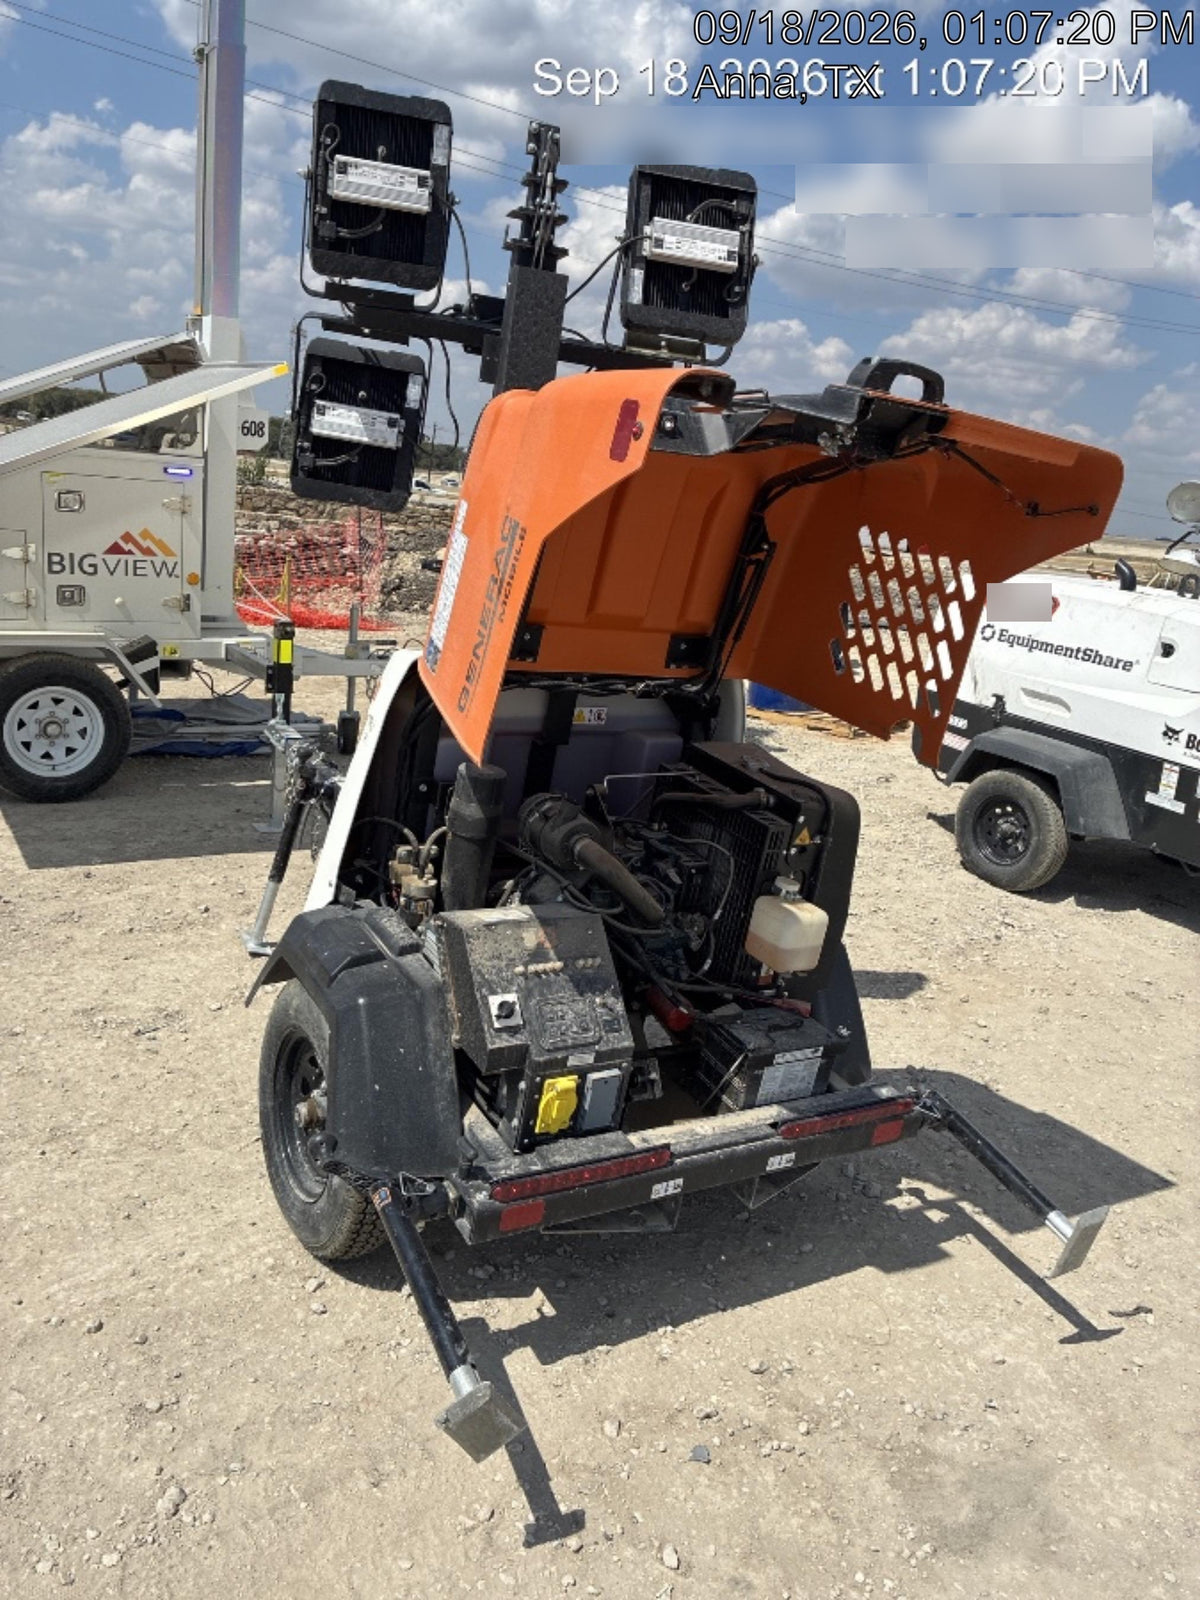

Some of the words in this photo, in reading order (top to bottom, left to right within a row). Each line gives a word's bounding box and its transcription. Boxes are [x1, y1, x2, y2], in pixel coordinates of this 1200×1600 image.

[241, 420, 265, 438] 608
[457, 514, 521, 713] GENERAC
[997, 628, 1134, 673] EquipmentShare
